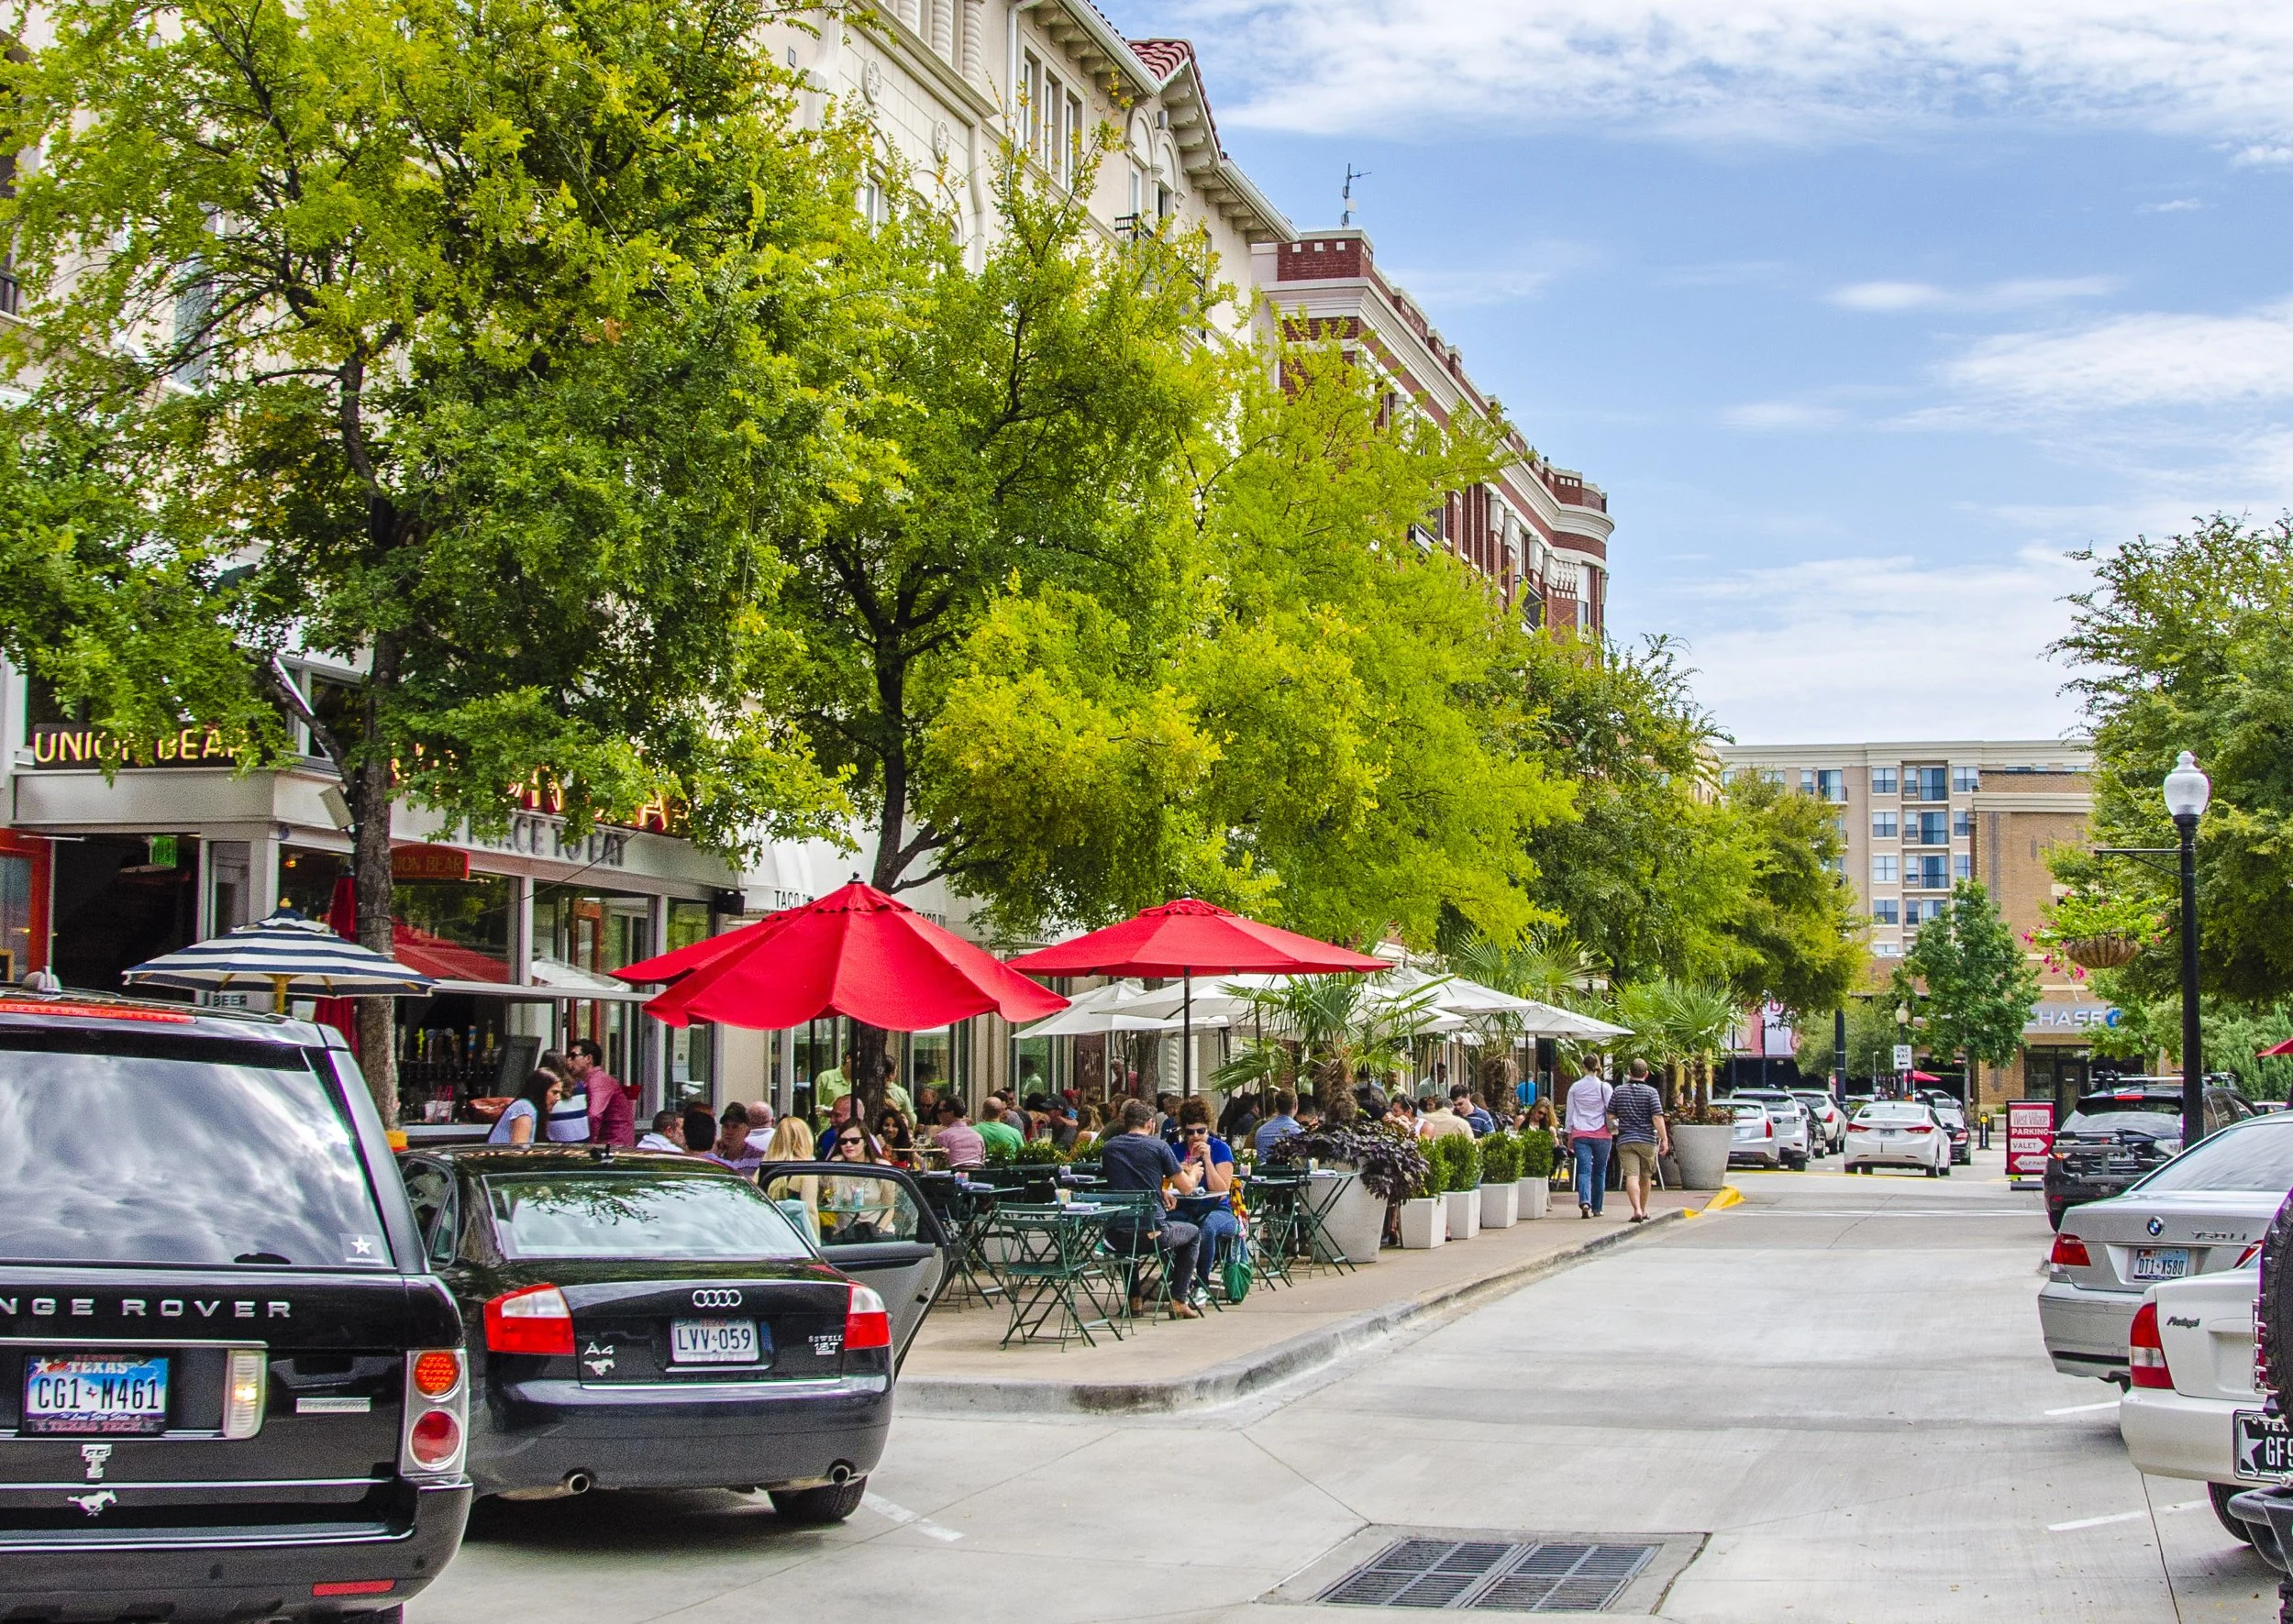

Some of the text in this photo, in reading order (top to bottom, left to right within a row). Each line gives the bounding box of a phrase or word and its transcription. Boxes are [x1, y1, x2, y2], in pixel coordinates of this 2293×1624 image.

[775, 890, 800, 909] TACO
[214, 995, 247, 1007] BEER
[2012, 1110, 2048, 1126] West Village
[121, 1299, 291, 1318] ROVER
[678, 1329, 751, 1350] LVV 059
[584, 1342, 615, 1355] A4
[68, 1362, 127, 1374] TEXAS
[39, 1377, 159, 1409] CG1 M461
